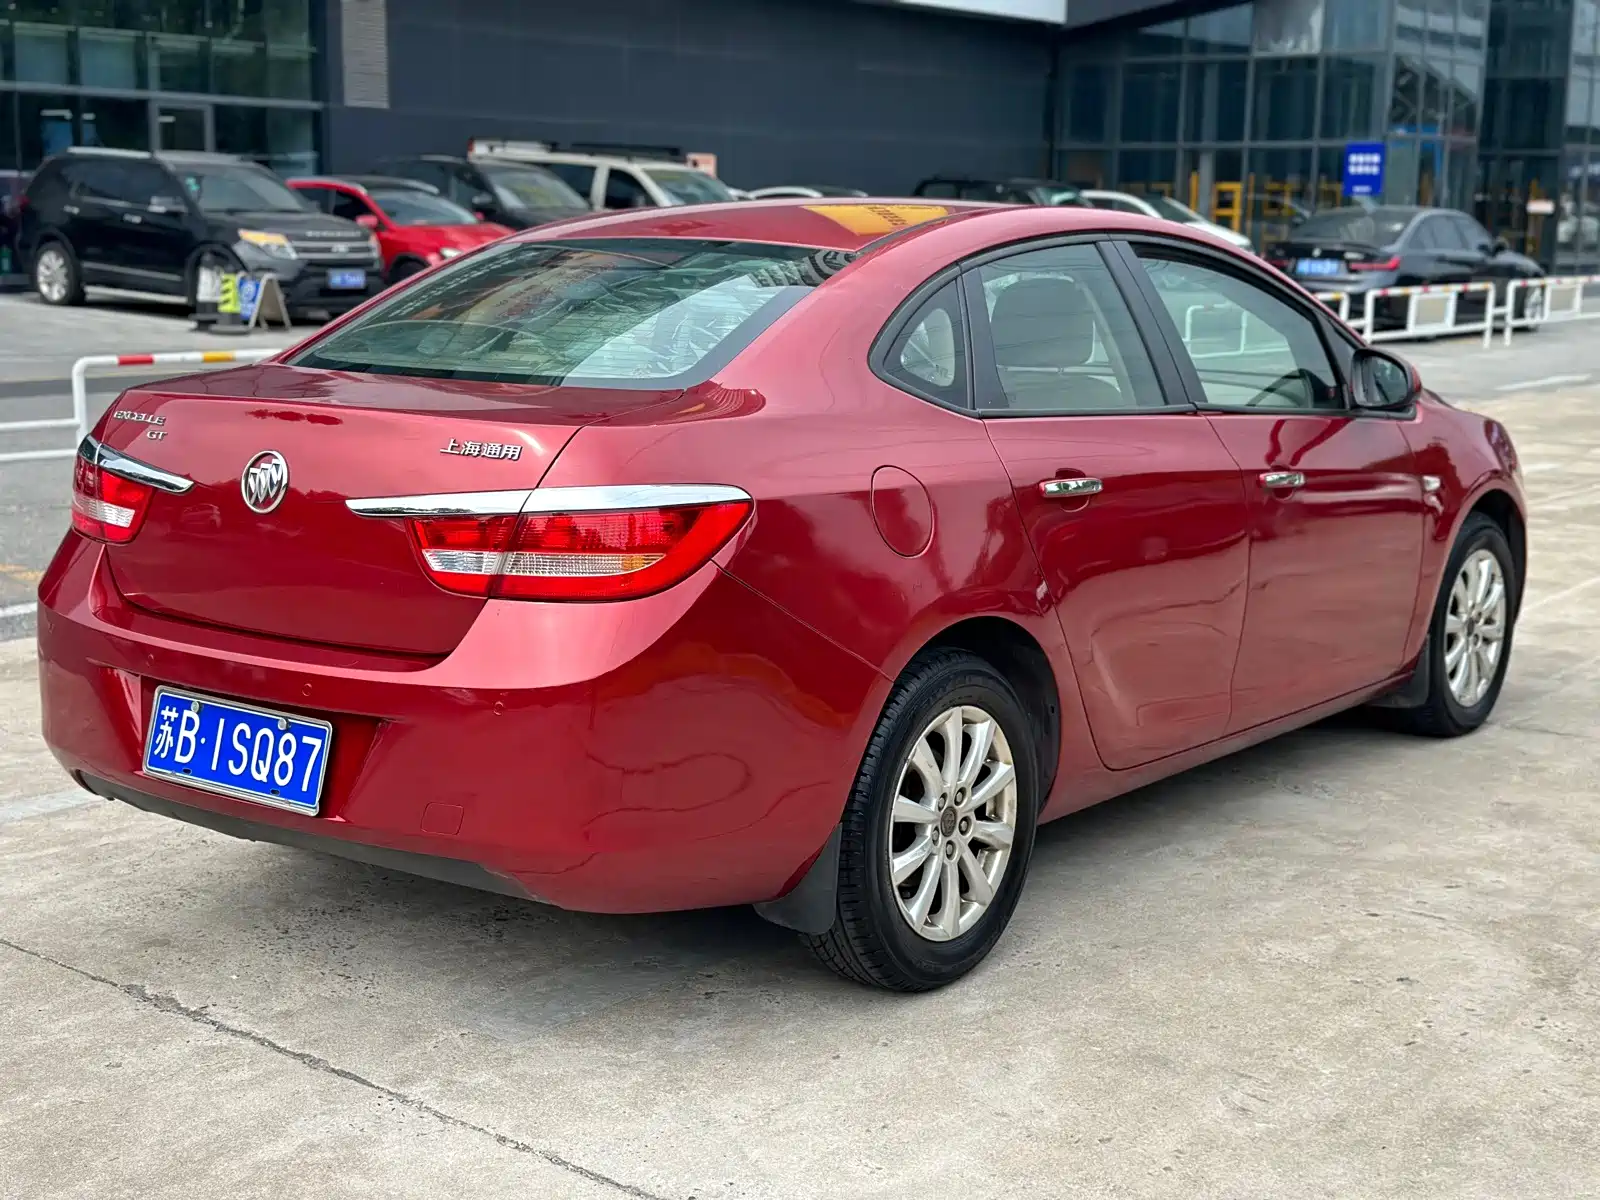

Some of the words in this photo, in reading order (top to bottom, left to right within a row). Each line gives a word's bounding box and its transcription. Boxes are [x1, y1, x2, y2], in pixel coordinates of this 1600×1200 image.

[113, 411, 166, 426] EXCELLE
[147, 430, 168, 441] GT
[439, 438, 523, 461] 上海通用
